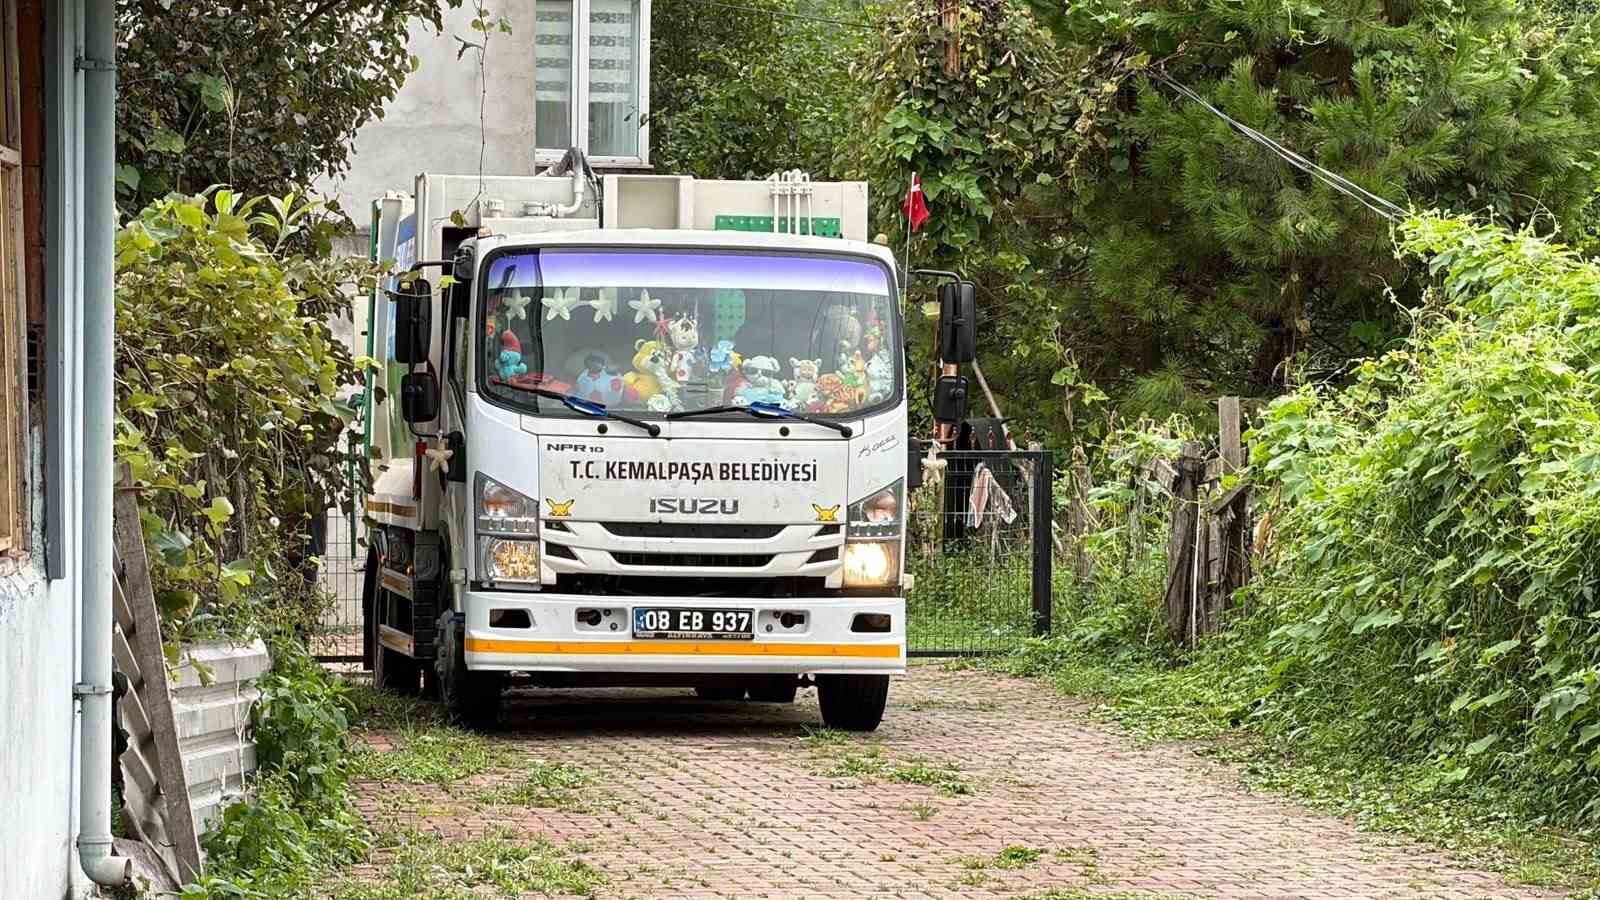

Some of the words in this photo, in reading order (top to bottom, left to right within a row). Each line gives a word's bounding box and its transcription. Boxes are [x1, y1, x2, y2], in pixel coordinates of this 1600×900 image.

[547, 443, 587, 453] NPR
[570, 461, 600, 479] T.C.
[606, 461, 714, 485] KEMALPAŞA
[720, 458, 817, 481] BELEDİYESİ
[649, 498, 739, 514] ISUZU
[645, 611, 670, 630] 08
[679, 611, 704, 631] EB
[712, 612, 750, 632] 937
